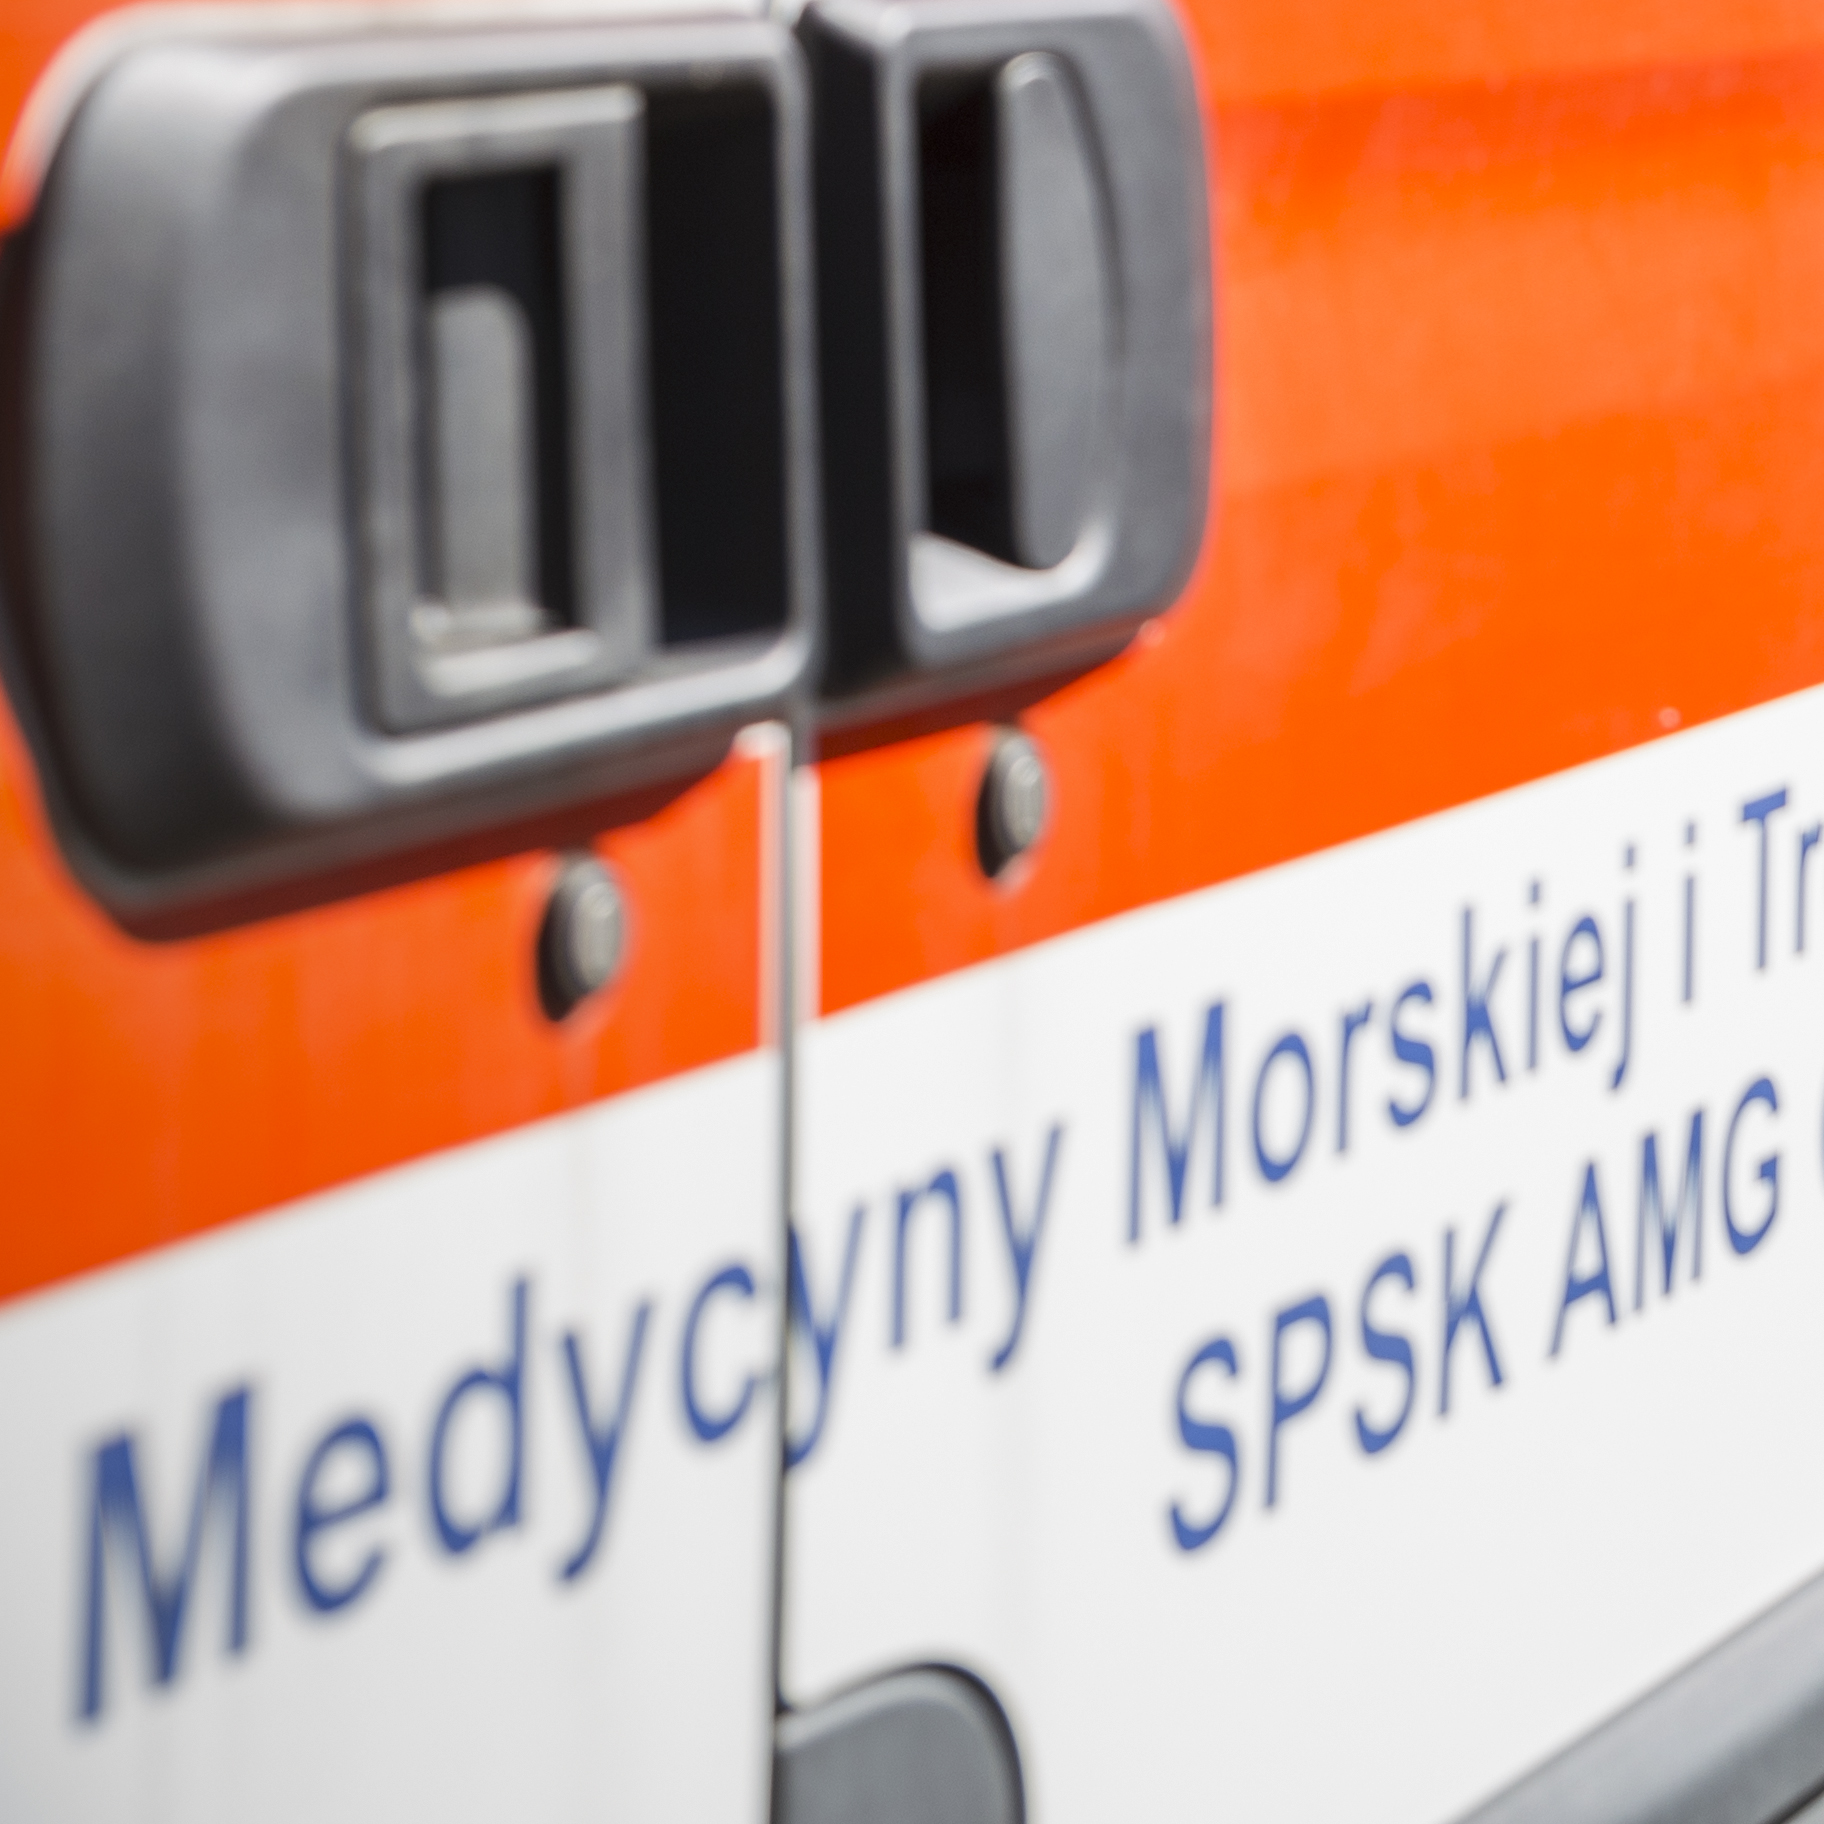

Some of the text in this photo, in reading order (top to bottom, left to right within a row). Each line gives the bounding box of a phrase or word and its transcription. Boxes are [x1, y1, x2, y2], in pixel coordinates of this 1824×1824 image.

[72, 1117, 1066, 1732] Medycyny
[1124, 841, 1640, 1250] Morskiej
[1682, 819, 1700, 1005] i
[1168, 1197, 1512, 1555] SPSK
[1547, 1074, 1784, 1362] AMG
